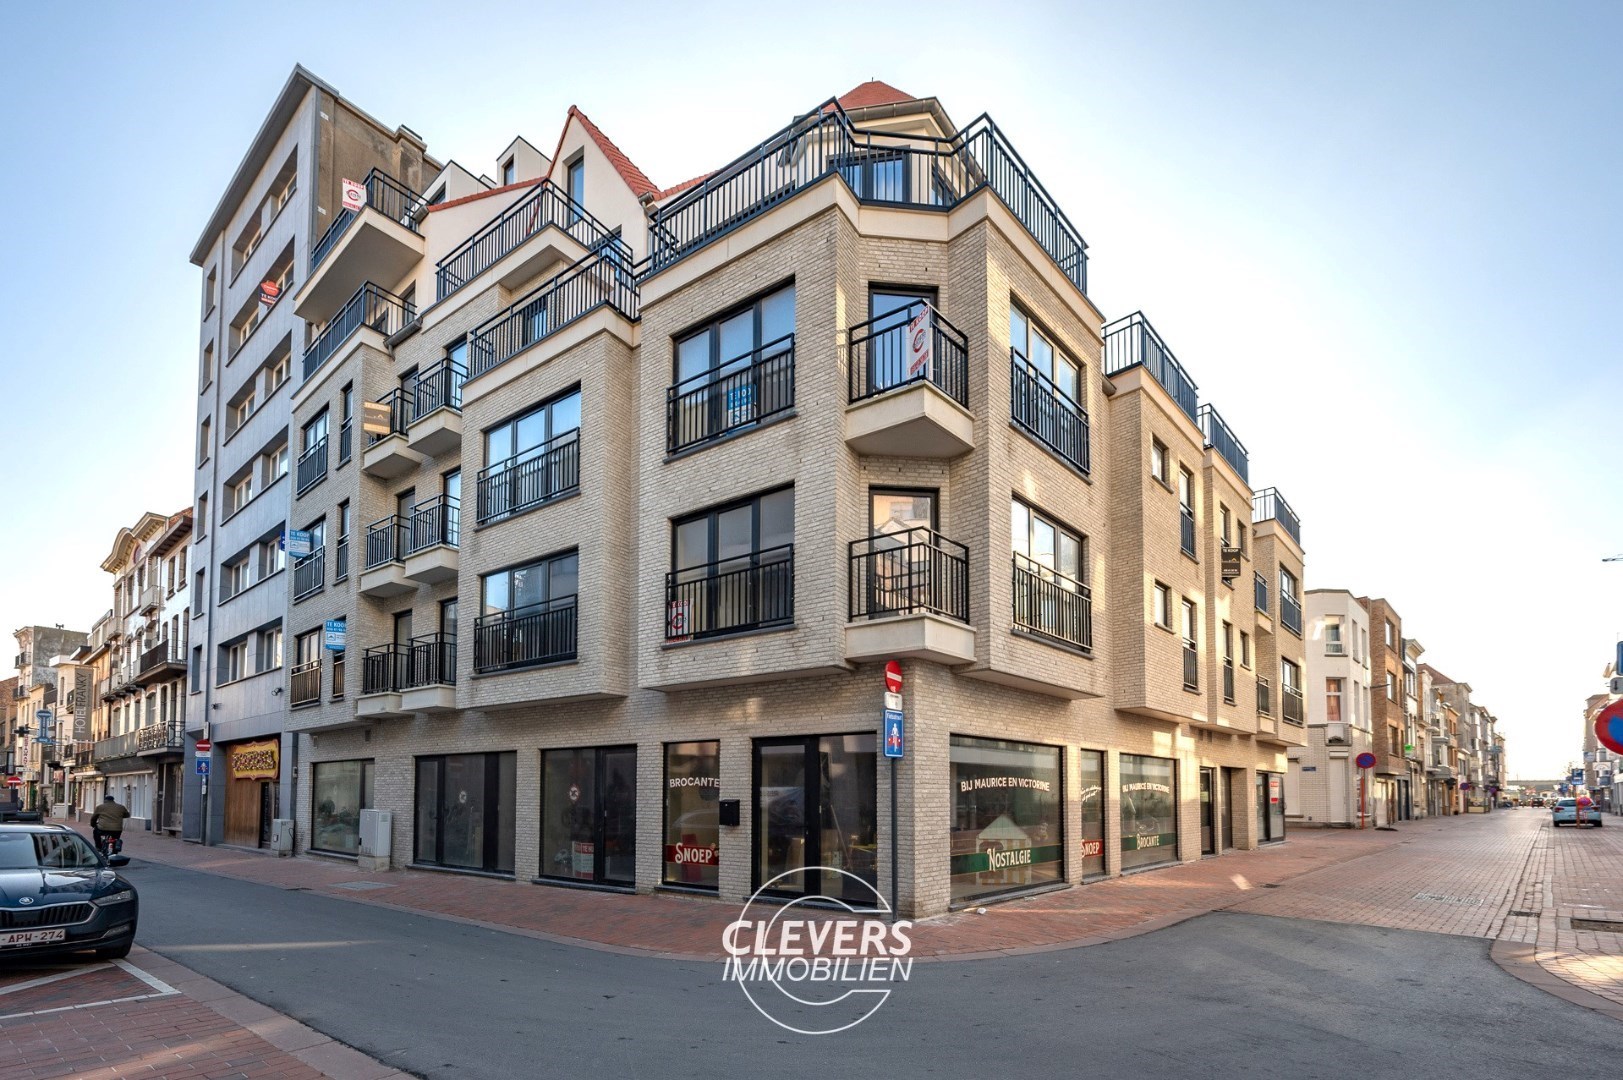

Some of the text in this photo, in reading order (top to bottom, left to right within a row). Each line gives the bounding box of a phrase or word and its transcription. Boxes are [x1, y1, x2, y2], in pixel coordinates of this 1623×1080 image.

[75, 672, 87, 733] HOTEL FRANKY
[669, 777, 720, 788] BROCANTE
[960, 777, 1050, 792] BIJ MAURICE EN VICTORINE
[1136, 833, 1159, 850] BROCANTE
